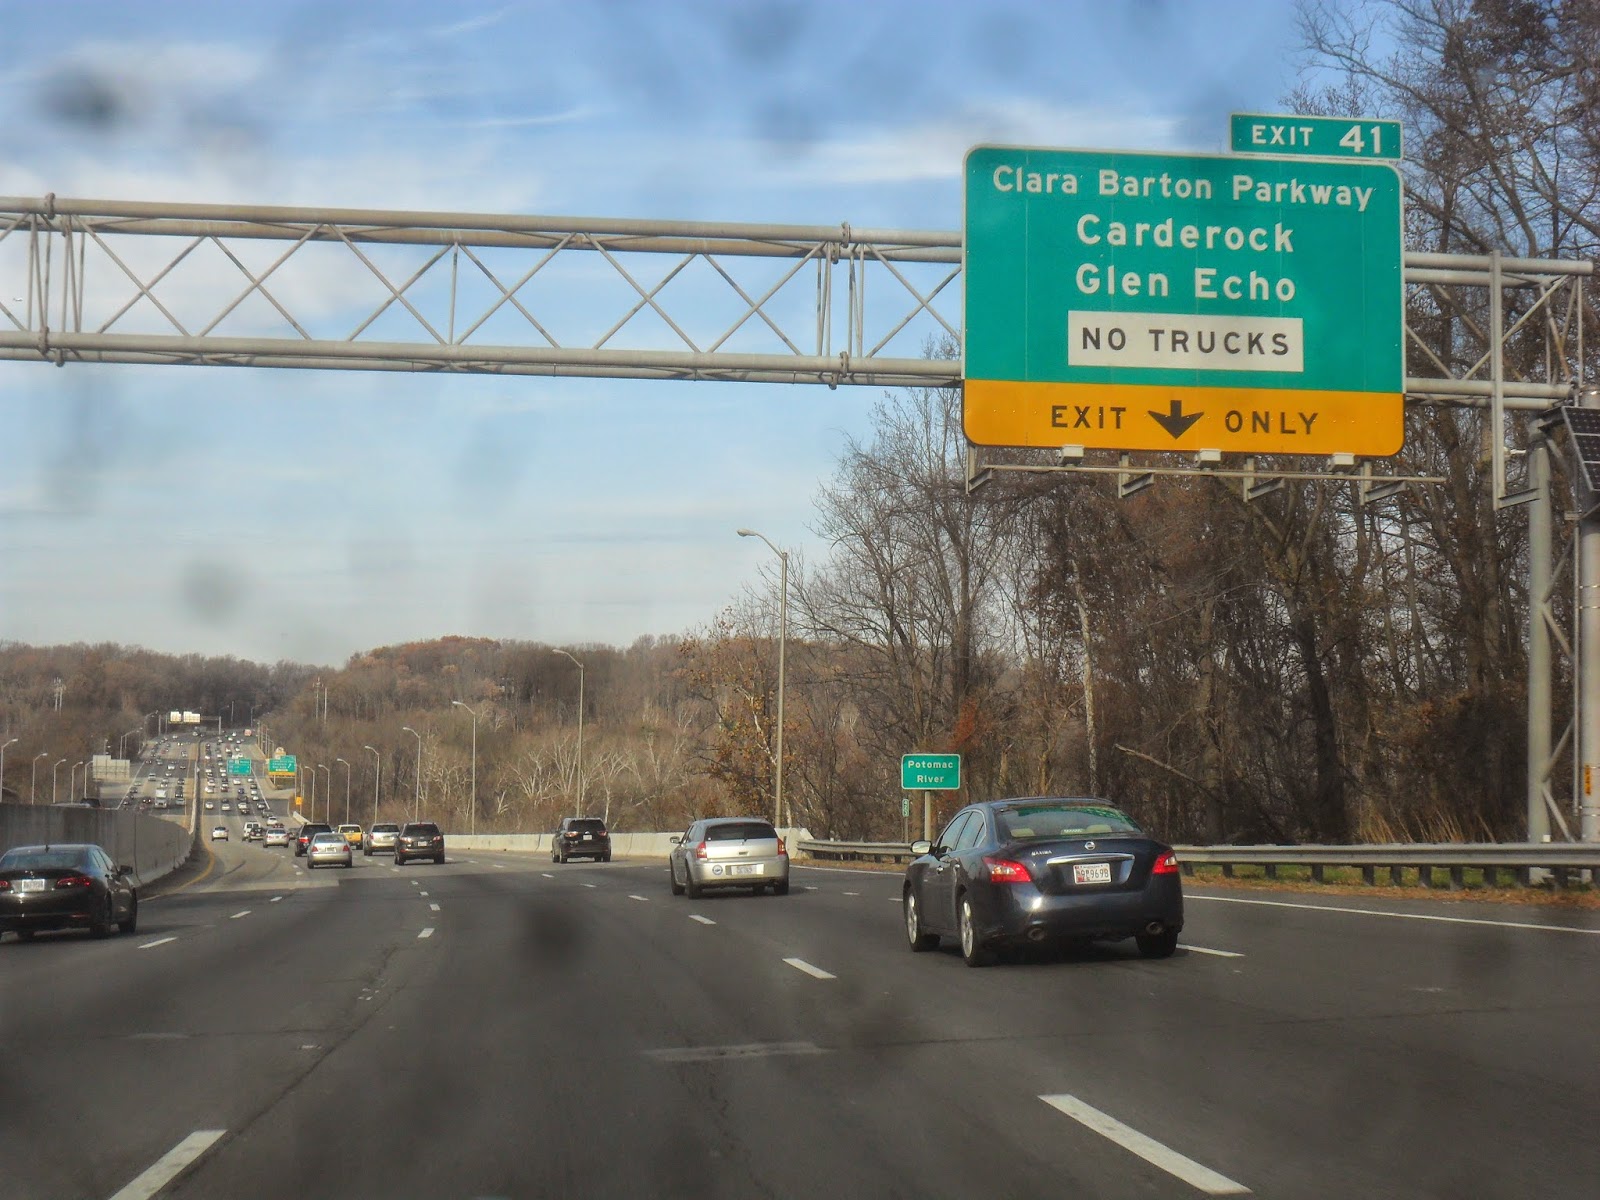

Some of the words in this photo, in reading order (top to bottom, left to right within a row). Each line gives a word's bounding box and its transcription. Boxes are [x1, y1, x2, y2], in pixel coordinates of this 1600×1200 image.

[1251, 125, 1314, 146] EXIT
[1339, 125, 1381, 154] 41
[993, 166, 1078, 194] Clara
[1099, 170, 1213, 200] Barton
[1232, 175, 1372, 212] Parkway
[1076, 213, 1294, 253] Carderock
[1076, 264, 1169, 297] Glen
[1195, 268, 1296, 302] Echo
[1082, 327, 1126, 351] NO
[1149, 329, 1289, 356] TRUCKS
[1051, 406, 1127, 429] EXIT
[1225, 410, 1318, 435] ONLY
[908, 760, 953, 768] Potomac
[917, 775, 944, 783] River
